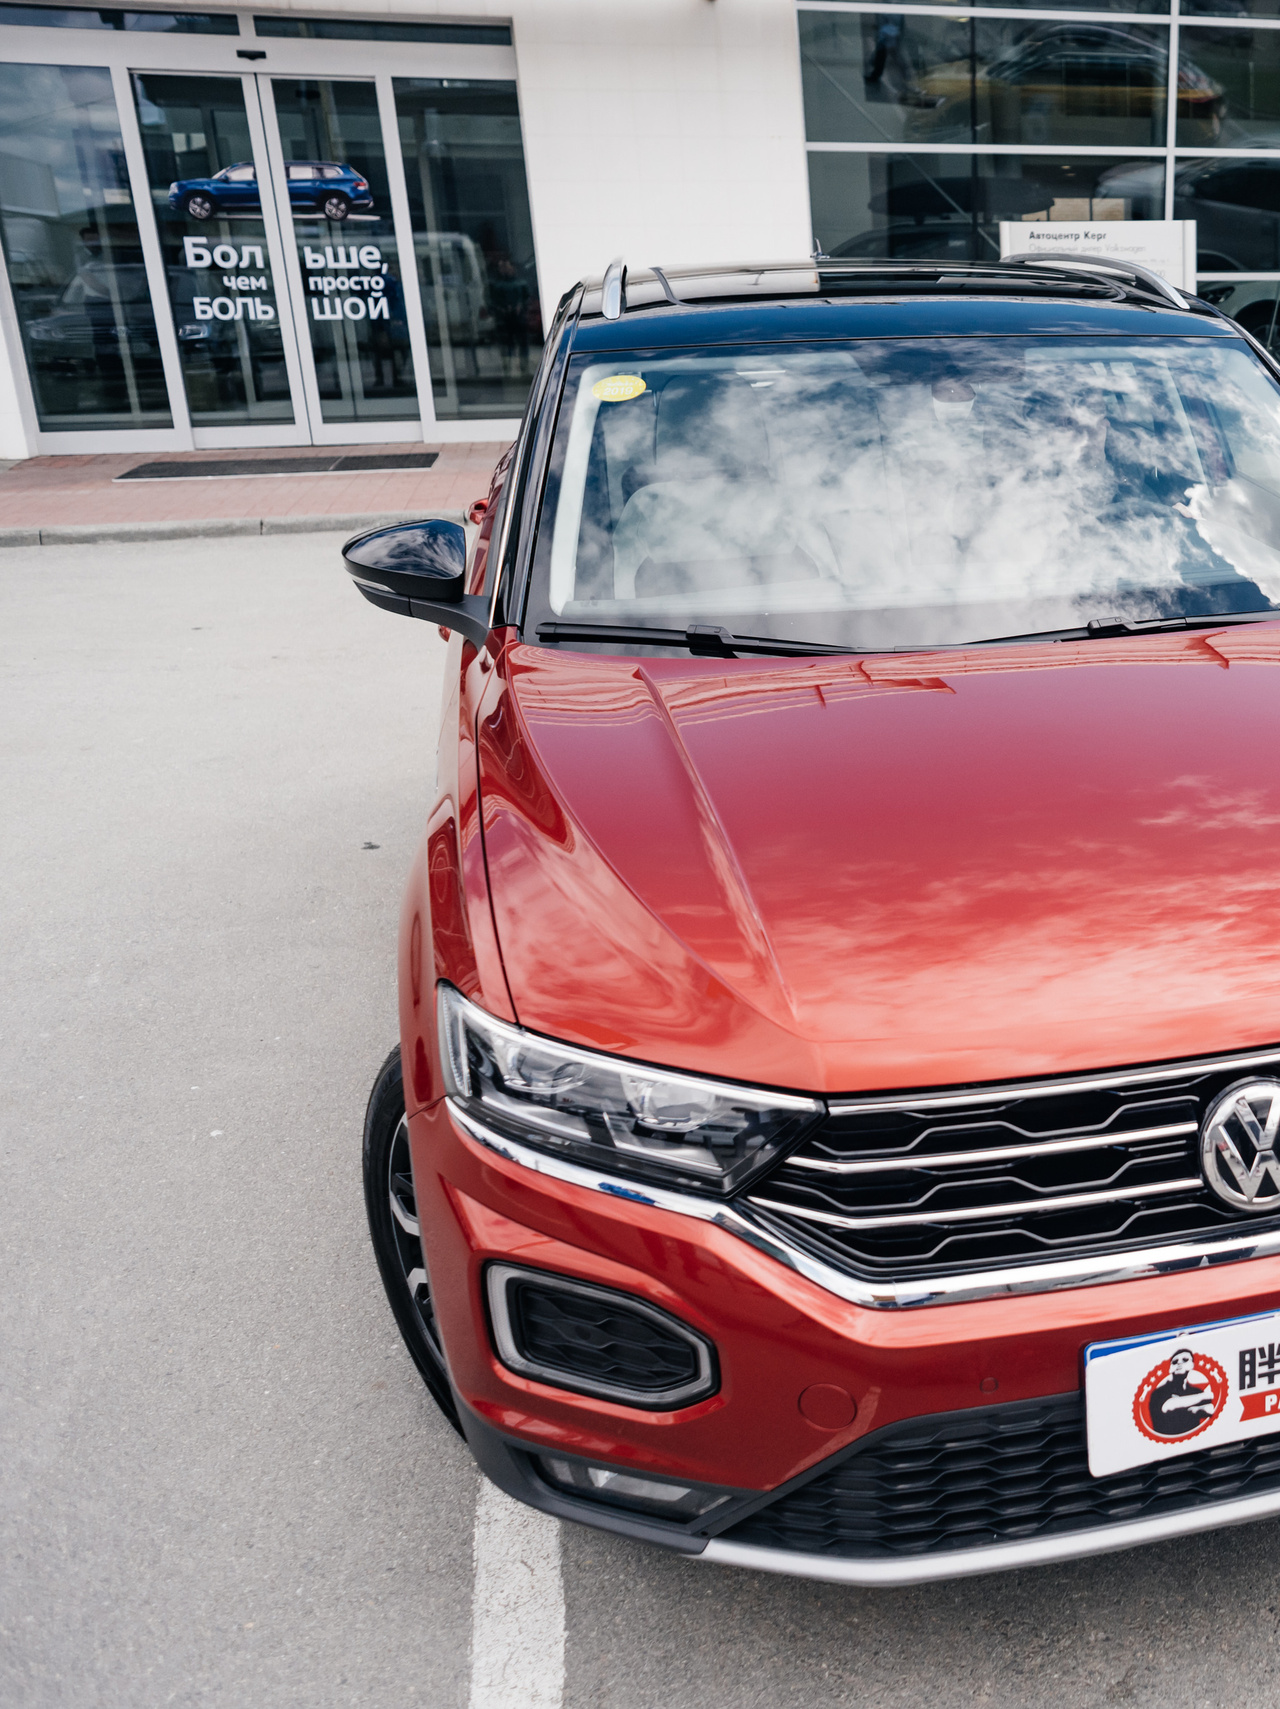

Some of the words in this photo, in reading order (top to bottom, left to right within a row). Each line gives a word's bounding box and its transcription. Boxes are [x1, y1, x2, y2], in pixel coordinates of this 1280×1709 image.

[1029, 231, 1080, 242] Автоцентр
[182, 236, 264, 268] Бол
[303, 245, 388, 274] ьше,
[222, 275, 267, 291] чем
[308, 275, 385, 295] просто
[603, 386, 634, 396] 2019
